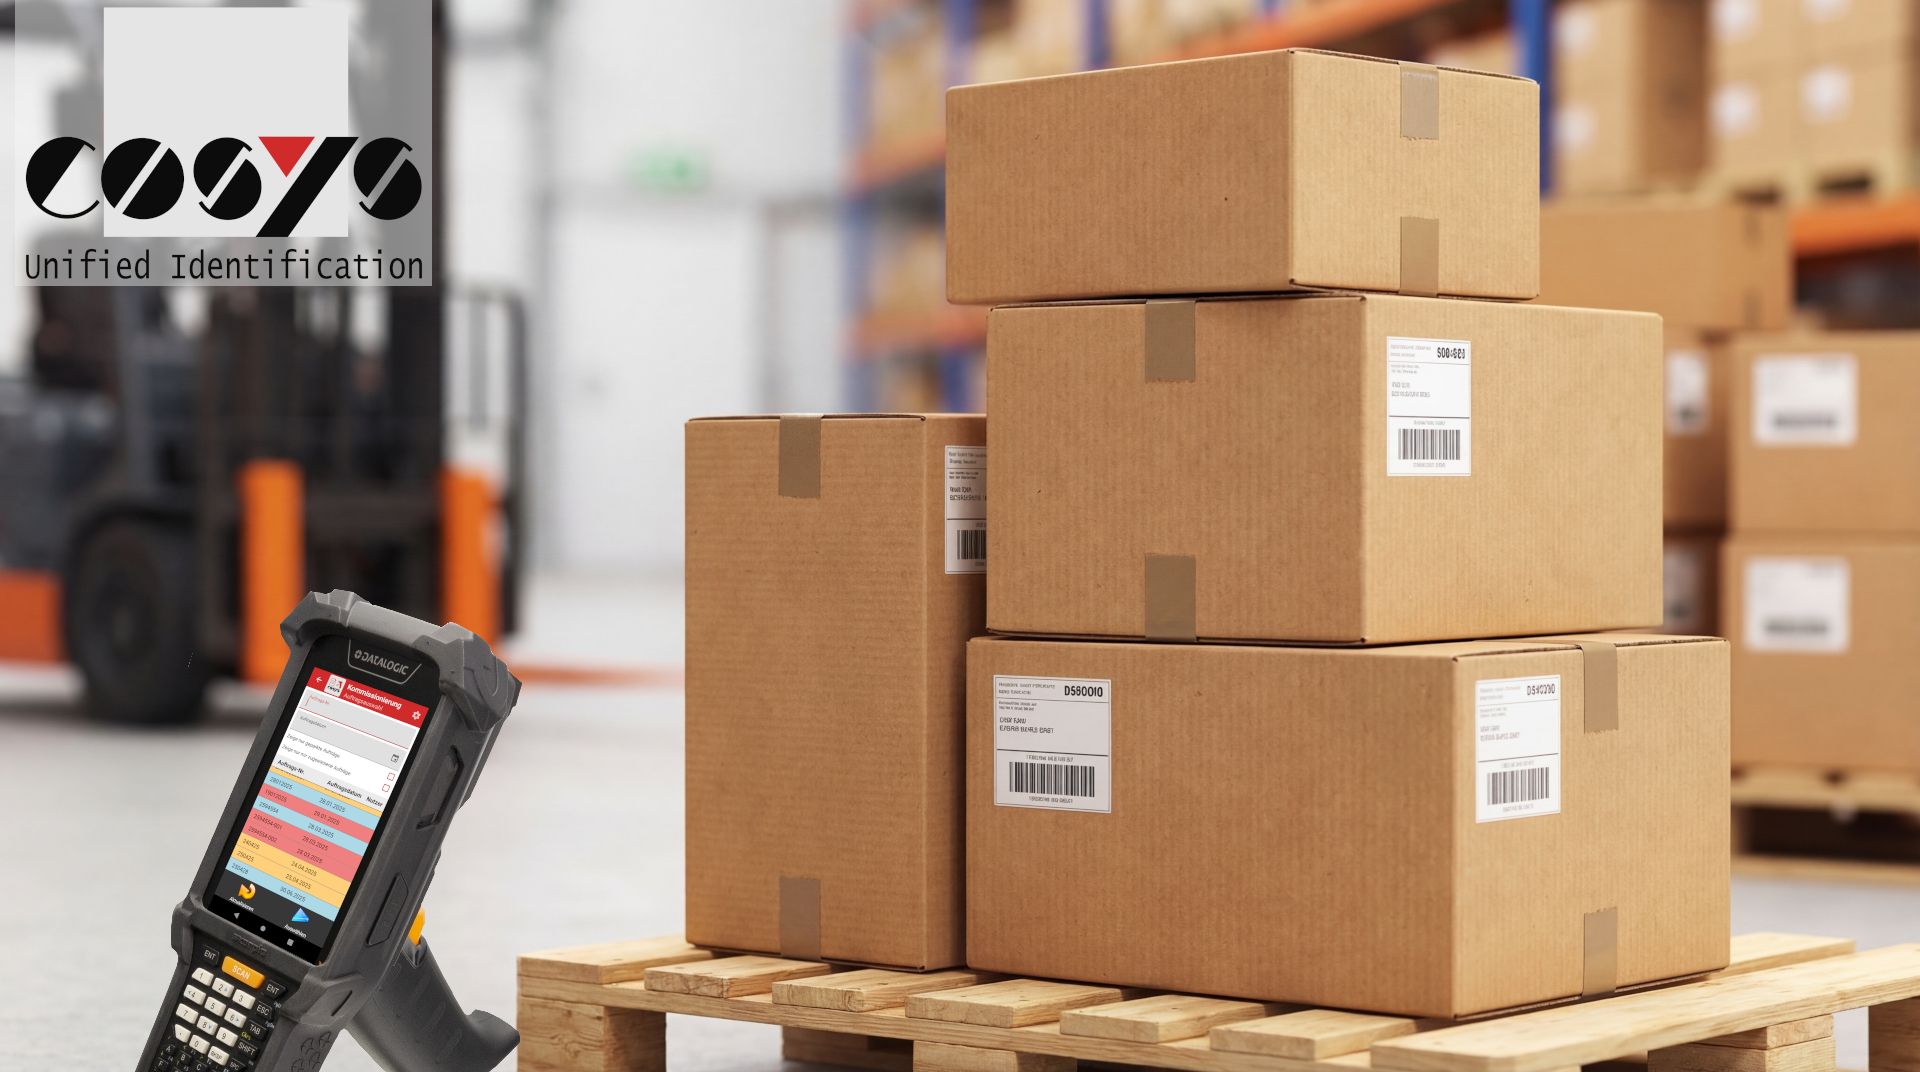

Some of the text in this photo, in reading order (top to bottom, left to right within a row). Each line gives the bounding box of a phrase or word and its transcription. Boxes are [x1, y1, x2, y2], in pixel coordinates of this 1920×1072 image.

[362, 652, 409, 675] DATALOGIC
[347, 683, 402, 710] Kommissionierung
[204, 950, 216, 960] ENT
[232, 965, 250, 980] SCAN
[266, 984, 279, 995] ENT
[256, 1004, 270, 1016] ESC
[250, 1024, 261, 1035] TAB
[238, 1039, 256, 1056] SHIFT
